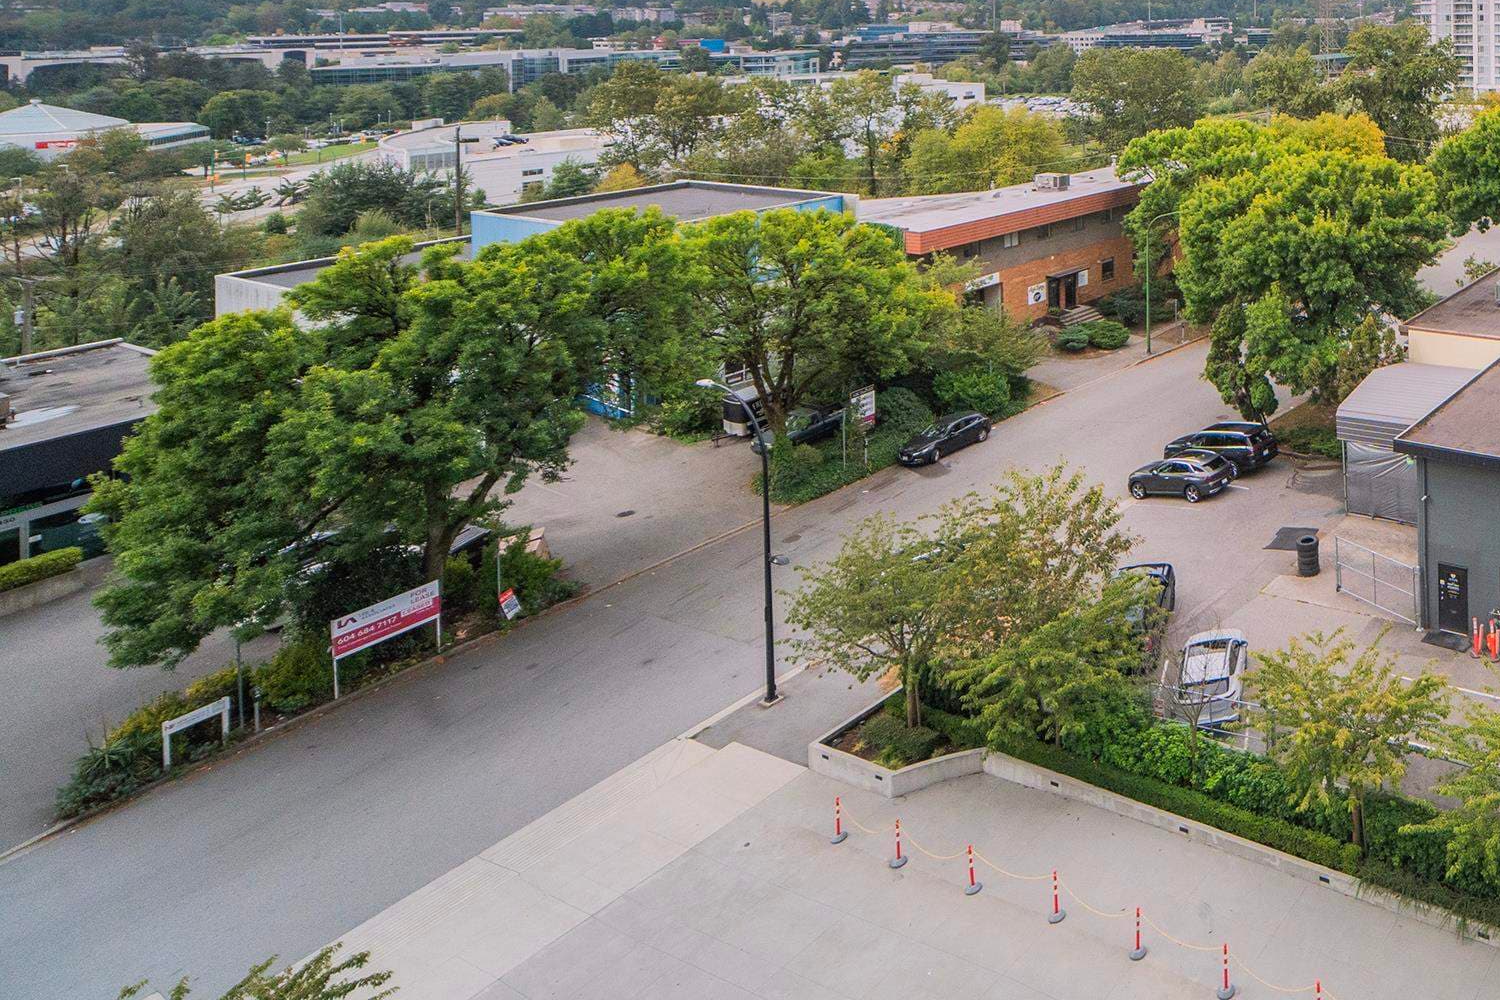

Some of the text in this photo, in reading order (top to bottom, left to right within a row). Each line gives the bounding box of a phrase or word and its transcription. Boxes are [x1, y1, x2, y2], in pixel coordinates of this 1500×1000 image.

[337, 633, 355, 646] 604
[357, 625, 376, 638] 684
[377, 615, 398, 629] 7117
